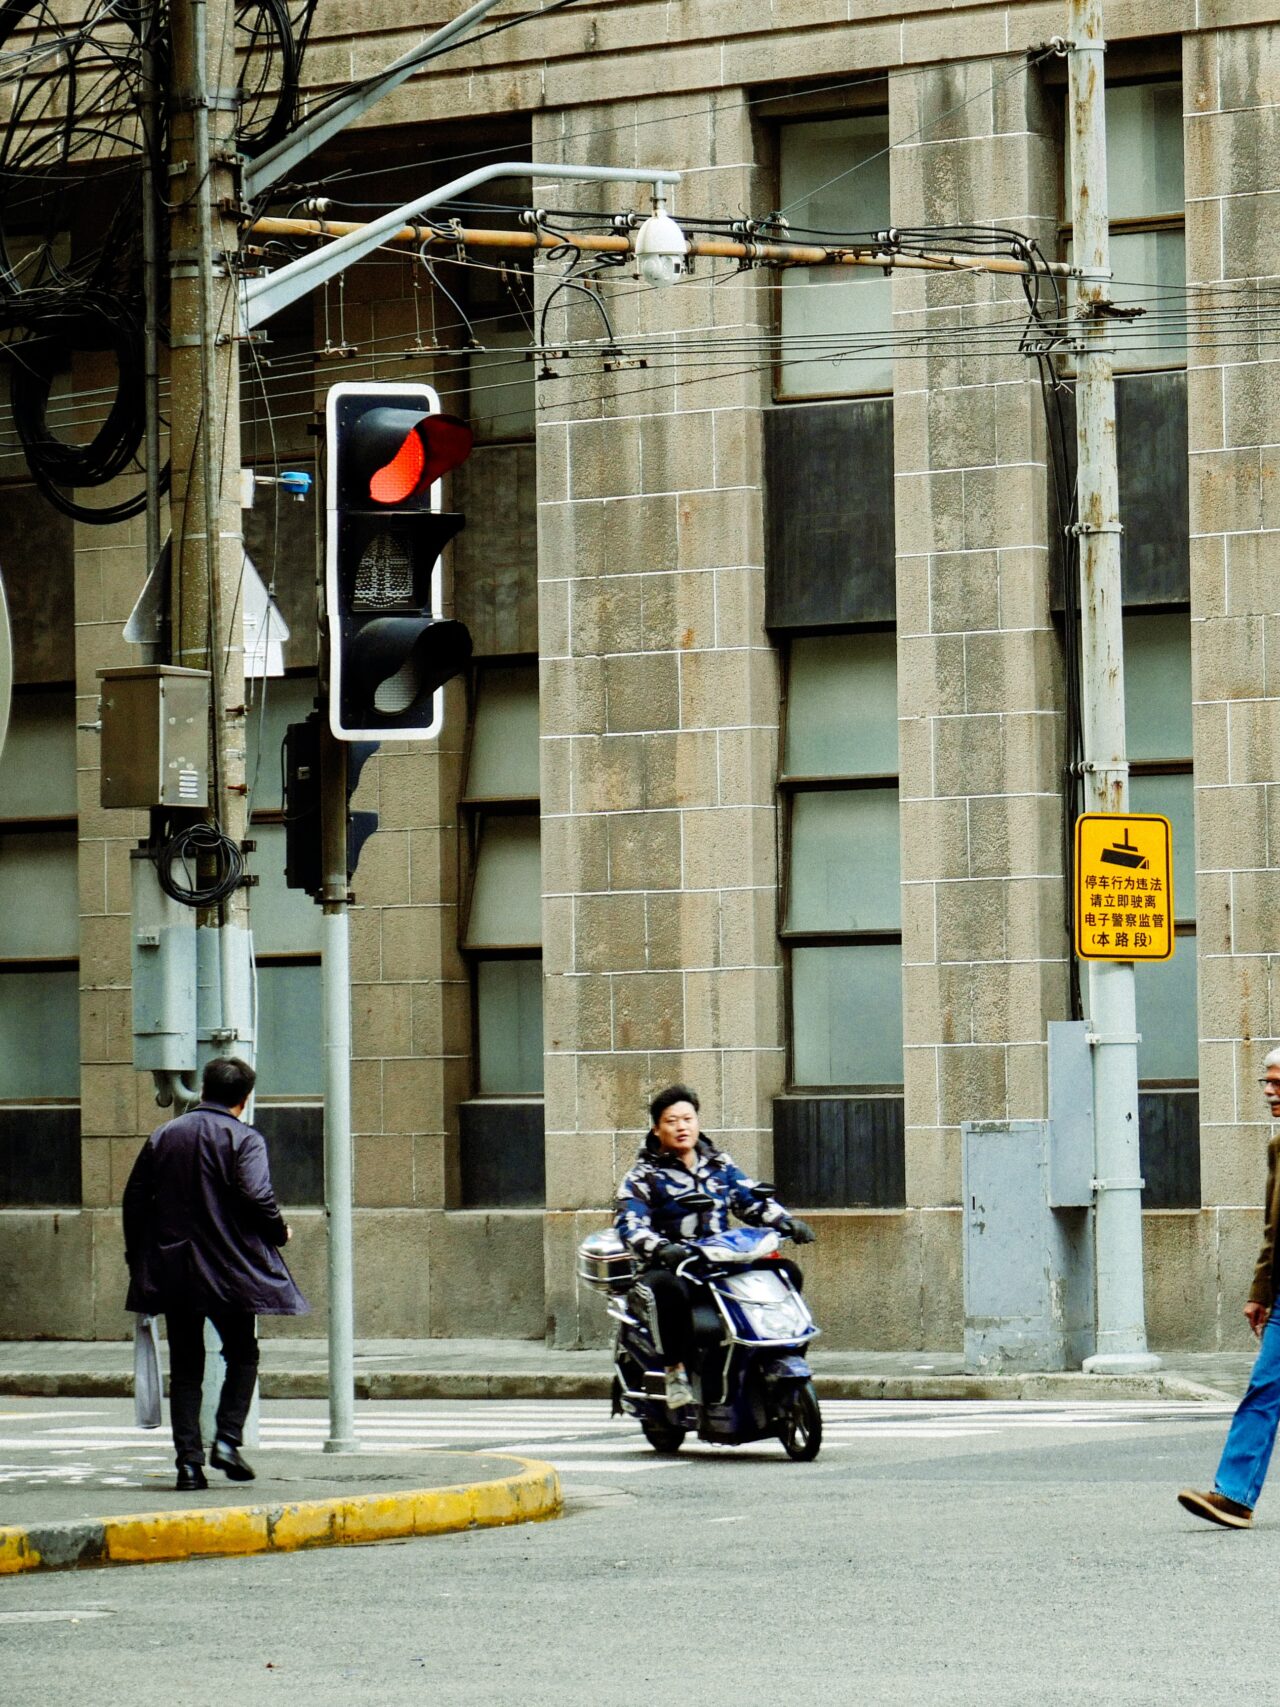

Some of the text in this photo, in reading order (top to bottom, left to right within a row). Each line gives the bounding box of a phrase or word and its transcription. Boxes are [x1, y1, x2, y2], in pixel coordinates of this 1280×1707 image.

[1085, 875, 1163, 891] 停车行为违法
[1090, 894, 1156, 908] 请立即驶离
[1085, 913, 1164, 928] 电子警察监管
